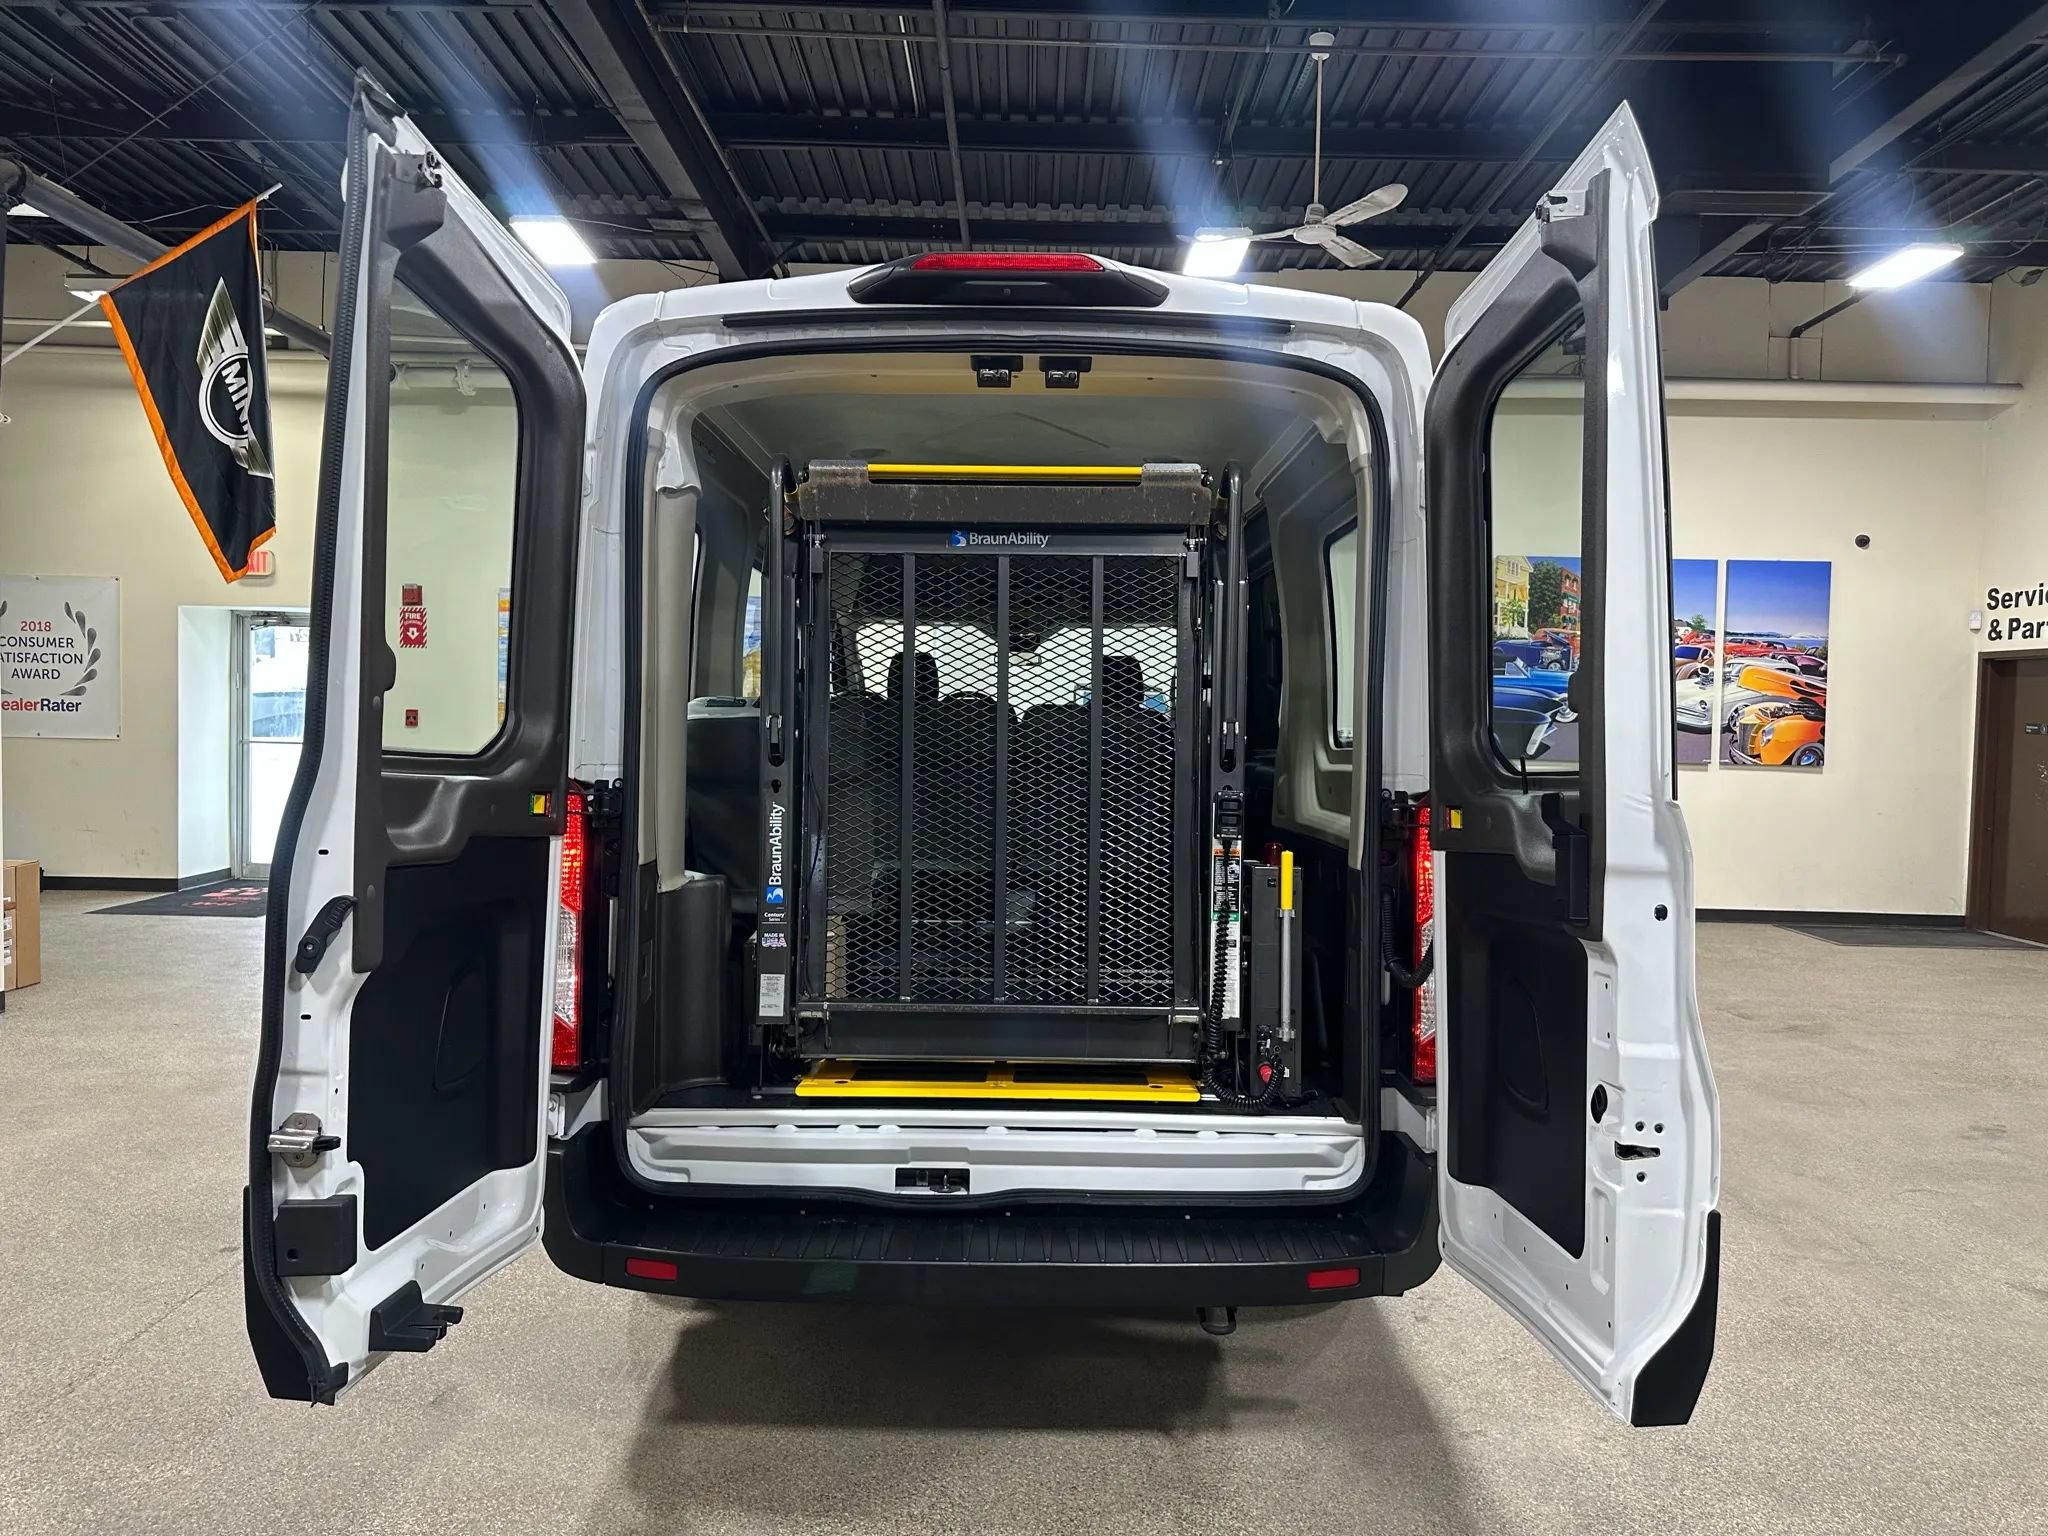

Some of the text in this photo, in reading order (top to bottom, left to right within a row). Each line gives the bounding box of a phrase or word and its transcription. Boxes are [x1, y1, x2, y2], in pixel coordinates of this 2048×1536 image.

[969, 532, 1049, 548] BraunAbility
[248, 551, 268, 573] XIT
[405, 612, 421, 620] FIRE
[20, 621, 52, 632] 2018
[1987, 618, 2002, 641] &
[0, 636, 74, 648] CONSUMER
[11, 668, 61, 680] AWARD
[768, 801, 786, 885] BraunAbility
